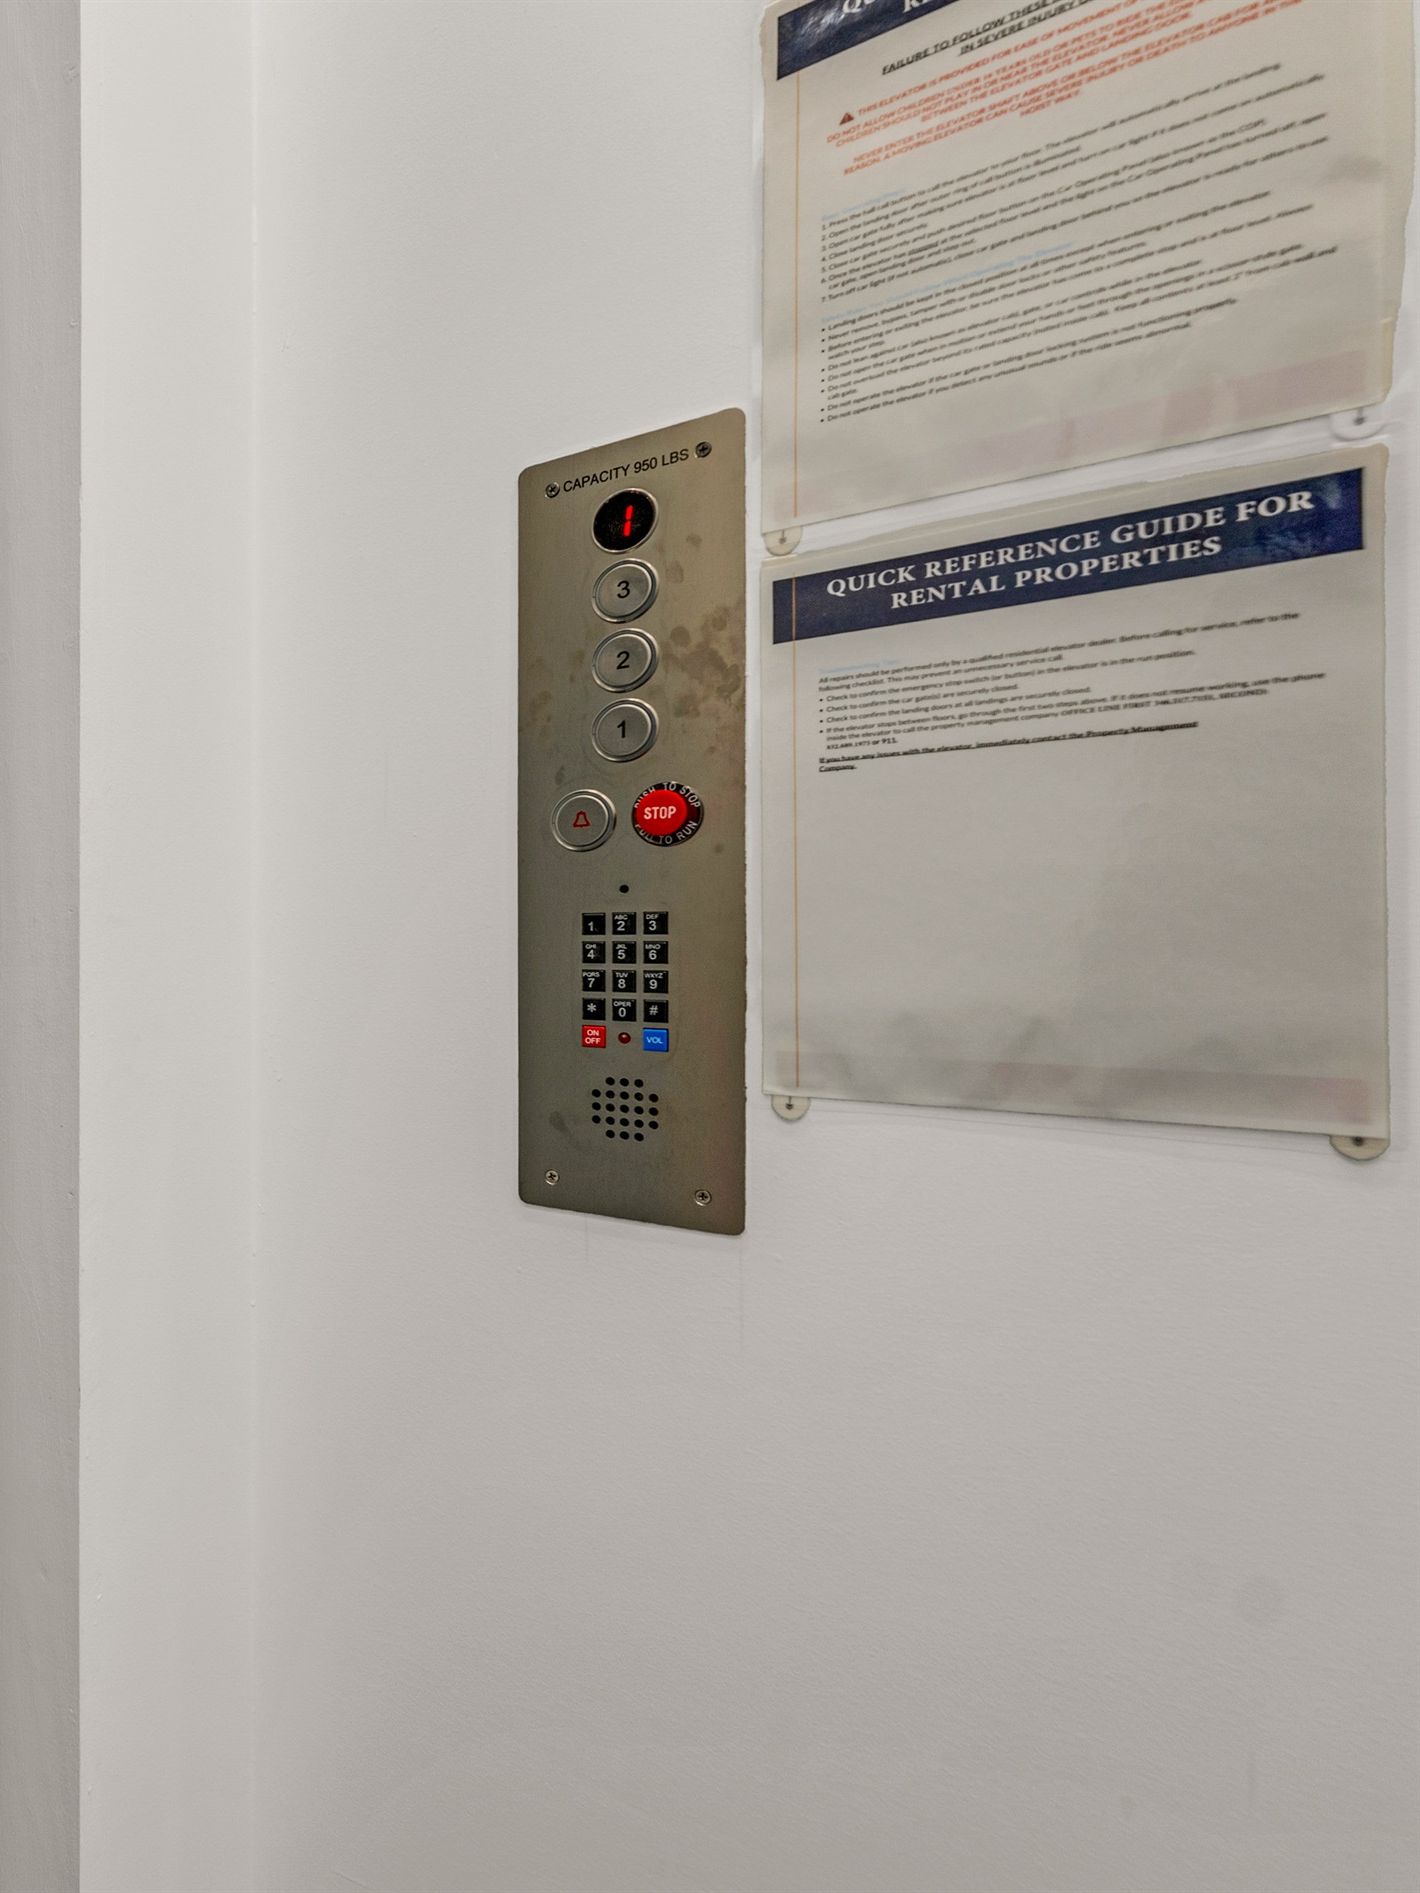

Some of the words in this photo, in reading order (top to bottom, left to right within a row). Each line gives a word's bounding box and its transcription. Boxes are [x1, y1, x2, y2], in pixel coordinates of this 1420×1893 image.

[959, 43, 975, 55] IN
[976, 21, 1024, 48] SEVERE
[1027, 0, 1075, 27] INJURY
[882, 48, 930, 75] FAILURE
[932, 40, 950, 54] TO
[951, 17, 1004, 46] FOLLOW
[1022, 0, 1049, 15] THESE
[857, 102, 877, 115] THIS
[878, 83, 927, 107] ELEVATOR
[928, 78, 937, 87] IS
[938, 57, 989, 82] PROVIDED
[990, 48, 1011, 60] FOR
[1013, 37, 1038, 52] EASE
[1040, 30, 1054, 41] OF
[1057, 3, 1121, 33] MOVEMENT
[921, 100, 967, 122] BETWEEN
[969, 90, 987, 102] THE
[989, 69, 1042, 95] ELEVATOR
[1044, 57, 1072, 72] GATE
[826, 132, 841, 143] DO
[841, 123, 861, 135] NOT
[862, 110, 895, 128] ALLOW
[896, 91, 944, 113] CHILDREN
[835, 125, 881, 147] CHILDREN
[881, 108, 921, 128] SHOULD
[921, 99, 942, 112] NOT
[944, 90, 968, 104] PLAY
[853, 147, 882, 162] NEVER
[884, 135, 913, 151] ENTER
[915, 127, 933, 139] THE
[563, 464, 630, 492] CAPACITY
[634, 458, 658, 473] 950
[662, 449, 689, 467] LBS
[623, 505, 633, 536] 1
[826, 565, 914, 596] QUICK
[925, 531, 1099, 577] REFERENCE
[1110, 507, 1224, 543] GUIDE
[1236, 491, 1313, 521] FOR
[891, 575, 1004, 608] RENTAL
[1015, 536, 1220, 587] PROPERTIES
[616, 580, 630, 599] 3
[616, 651, 630, 670] 2
[828, 674, 854, 682] repairs
[854, 670, 880, 678] should
[890, 663, 932, 674] performed
[932, 660, 950, 668] only
[968, 653, 1004, 663] qualified
[825, 704, 848, 712] Check
[858, 700, 887, 708] confirm
[955, 687, 989, 696] securely
[825, 715, 848, 723] Check
[857, 711, 887, 719] confirm
[901, 706, 929, 714] landing
[616, 720, 626, 738] 1
[663, 783, 677, 791] TO
[679, 784, 701, 808] STOP
[643, 805, 677, 820] STOP
[659, 835, 673, 844] TO
[676, 820, 698, 841] RUN
[588, 921, 594, 932] 1
[616, 921, 625, 931] 2
[648, 920, 657, 931] 3
[587, 950, 595, 959] 4
[617, 950, 626, 960] 5
[648, 950, 657, 960] 6
[588, 978, 595, 988] 7
[618, 978, 626, 989] 8
[649, 979, 658, 990] 9
[649, 1006, 658, 1016] #
[646, 1036, 663, 1044] VOL
